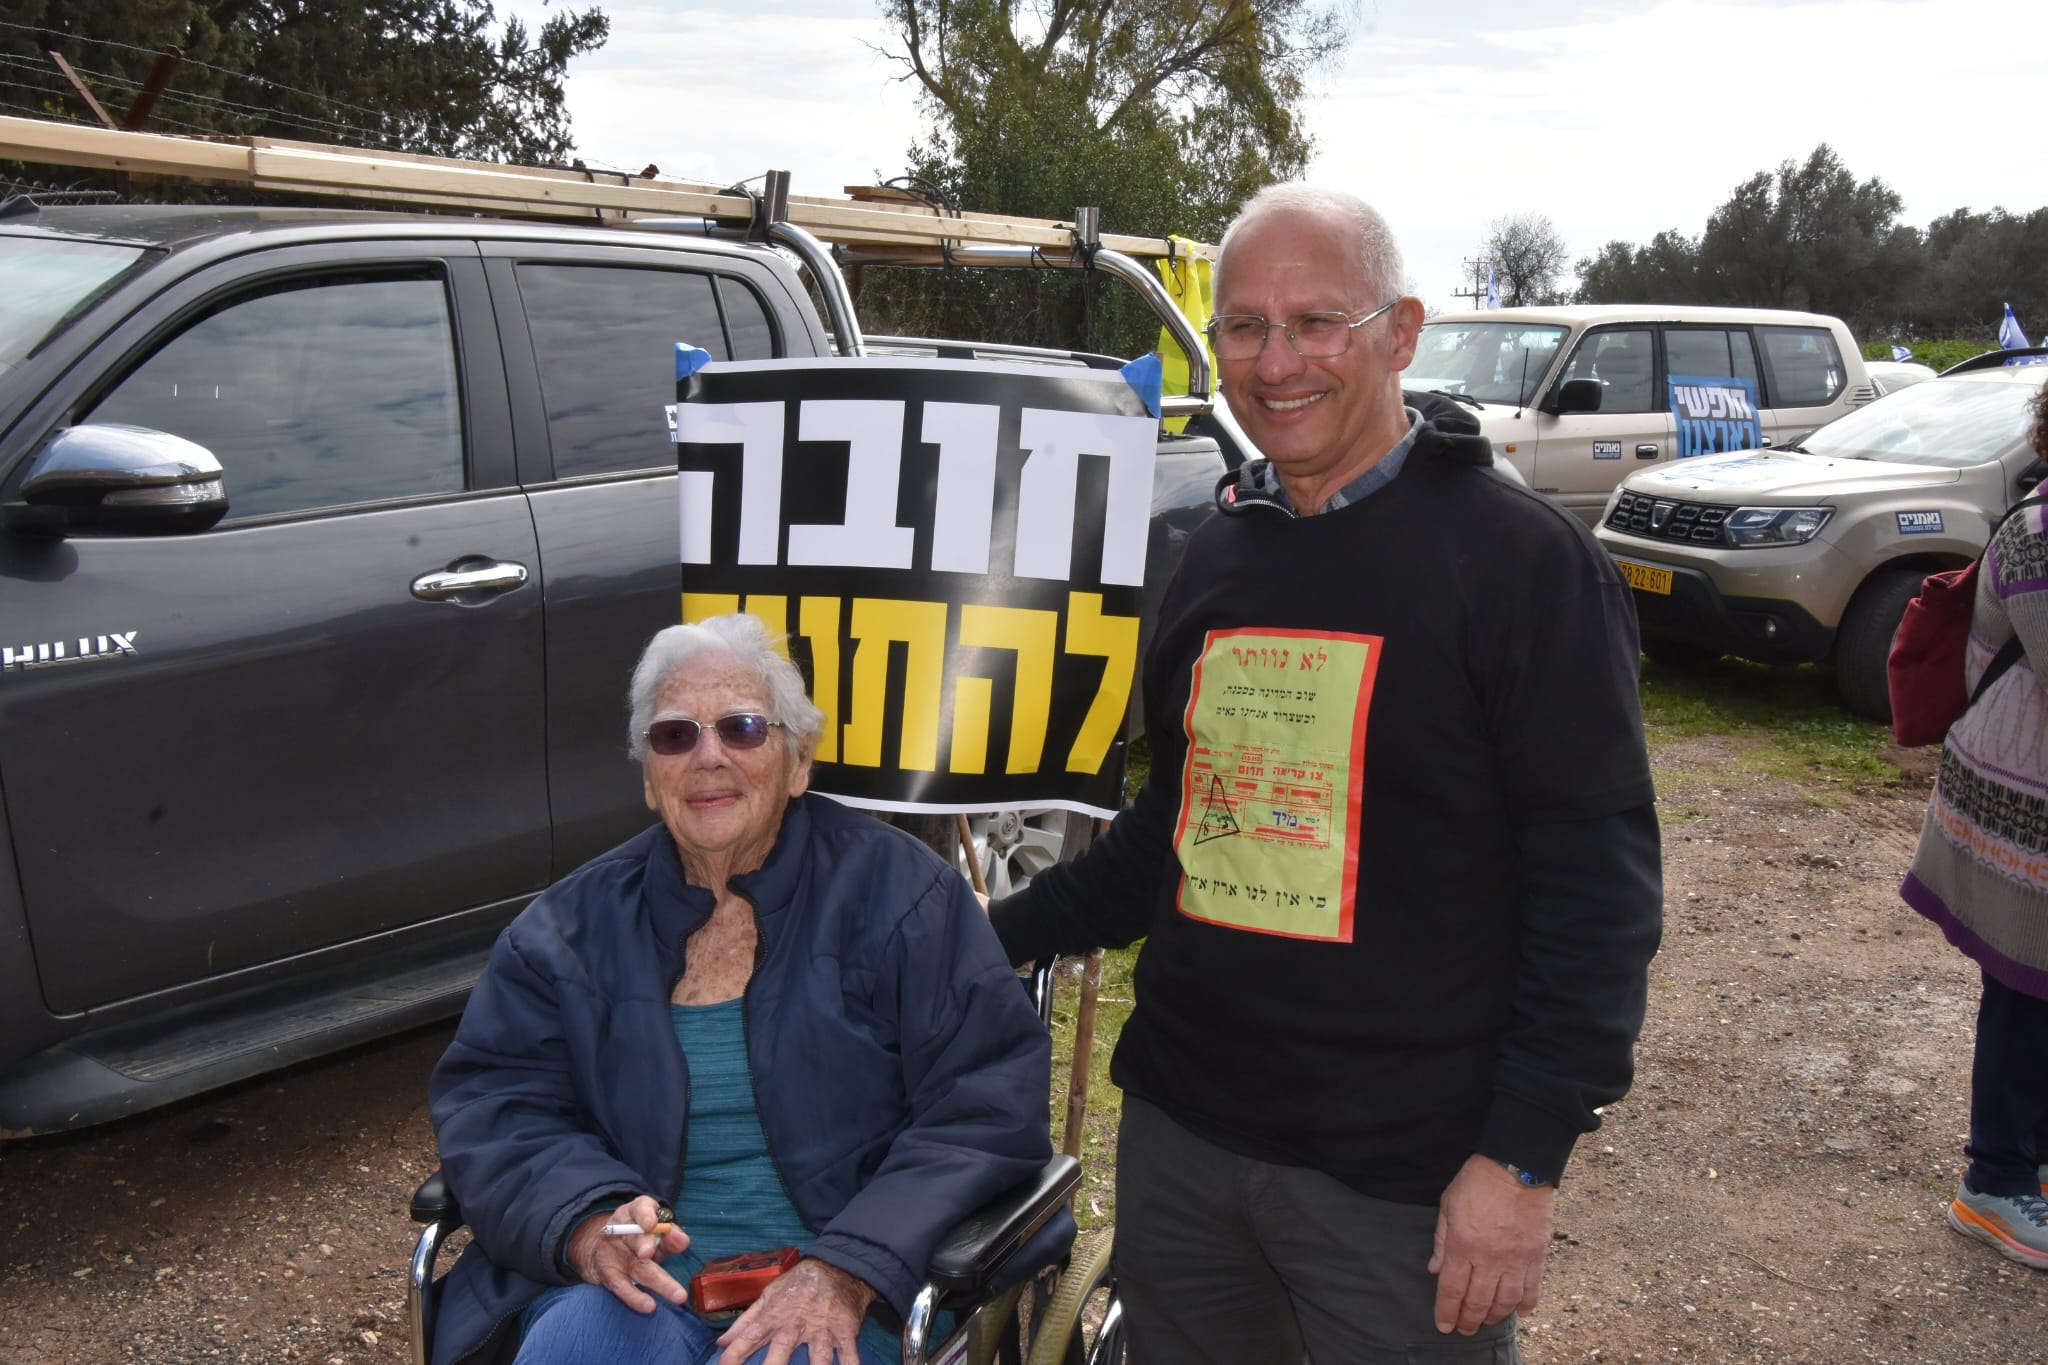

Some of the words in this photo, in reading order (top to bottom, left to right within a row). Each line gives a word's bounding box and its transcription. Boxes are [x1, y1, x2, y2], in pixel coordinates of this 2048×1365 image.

[1674, 386, 1753, 419] חופשי
[1594, 443, 1620, 453] נאמנים
[677, 400, 1159, 587] חובה
[1898, 512, 1942, 526] נאמנים
[2, 631, 138, 671] HILUX
[1299, 645, 1328, 672] לא
[682, 591, 1141, 776] להתנ
[1212, 879, 1238, 897] ארץ
[1245, 884, 1268, 902] לנו
[1276, 891, 1300, 907] אין
[1309, 894, 1327, 908] כי
